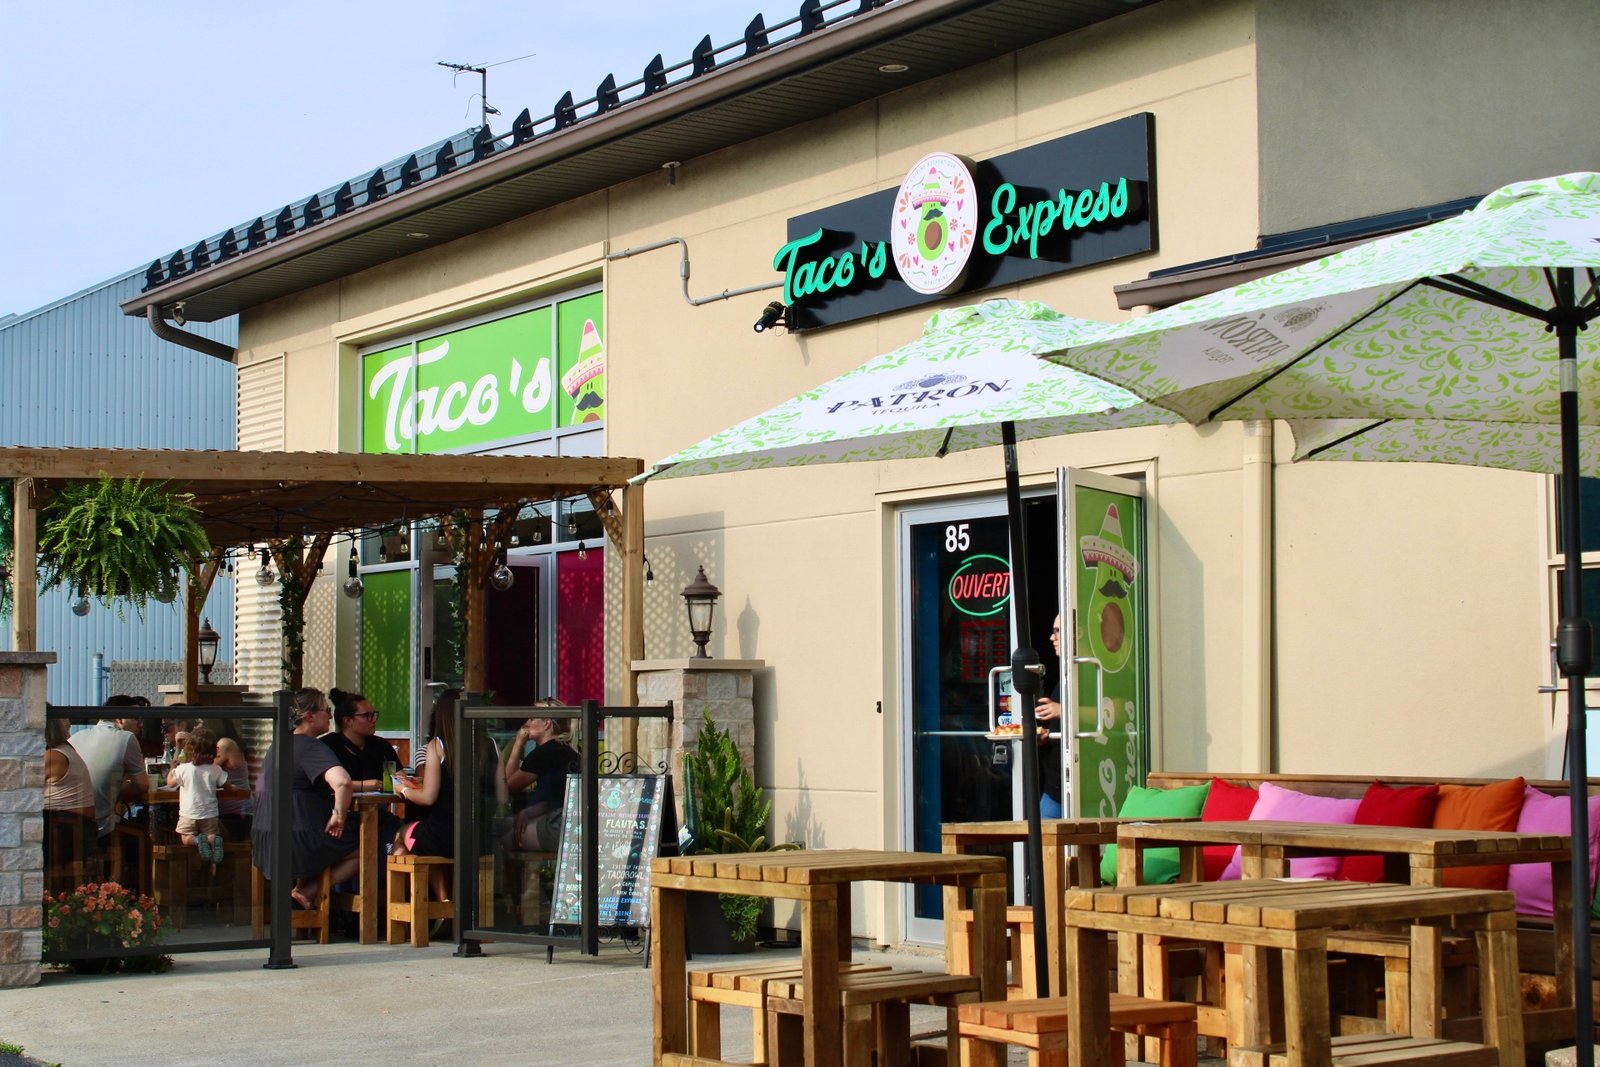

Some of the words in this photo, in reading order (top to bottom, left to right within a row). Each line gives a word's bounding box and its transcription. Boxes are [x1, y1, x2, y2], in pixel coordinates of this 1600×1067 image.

[982, 177, 1128, 260] Express
[773, 228, 887, 306] Taco's
[369, 340, 551, 451] Taco's
[827, 379, 1013, 414] PATRÓN
[871, 402, 941, 416] TEQUILA
[945, 523, 970, 552] 85
[952, 571, 1011, 600] OUVERT
